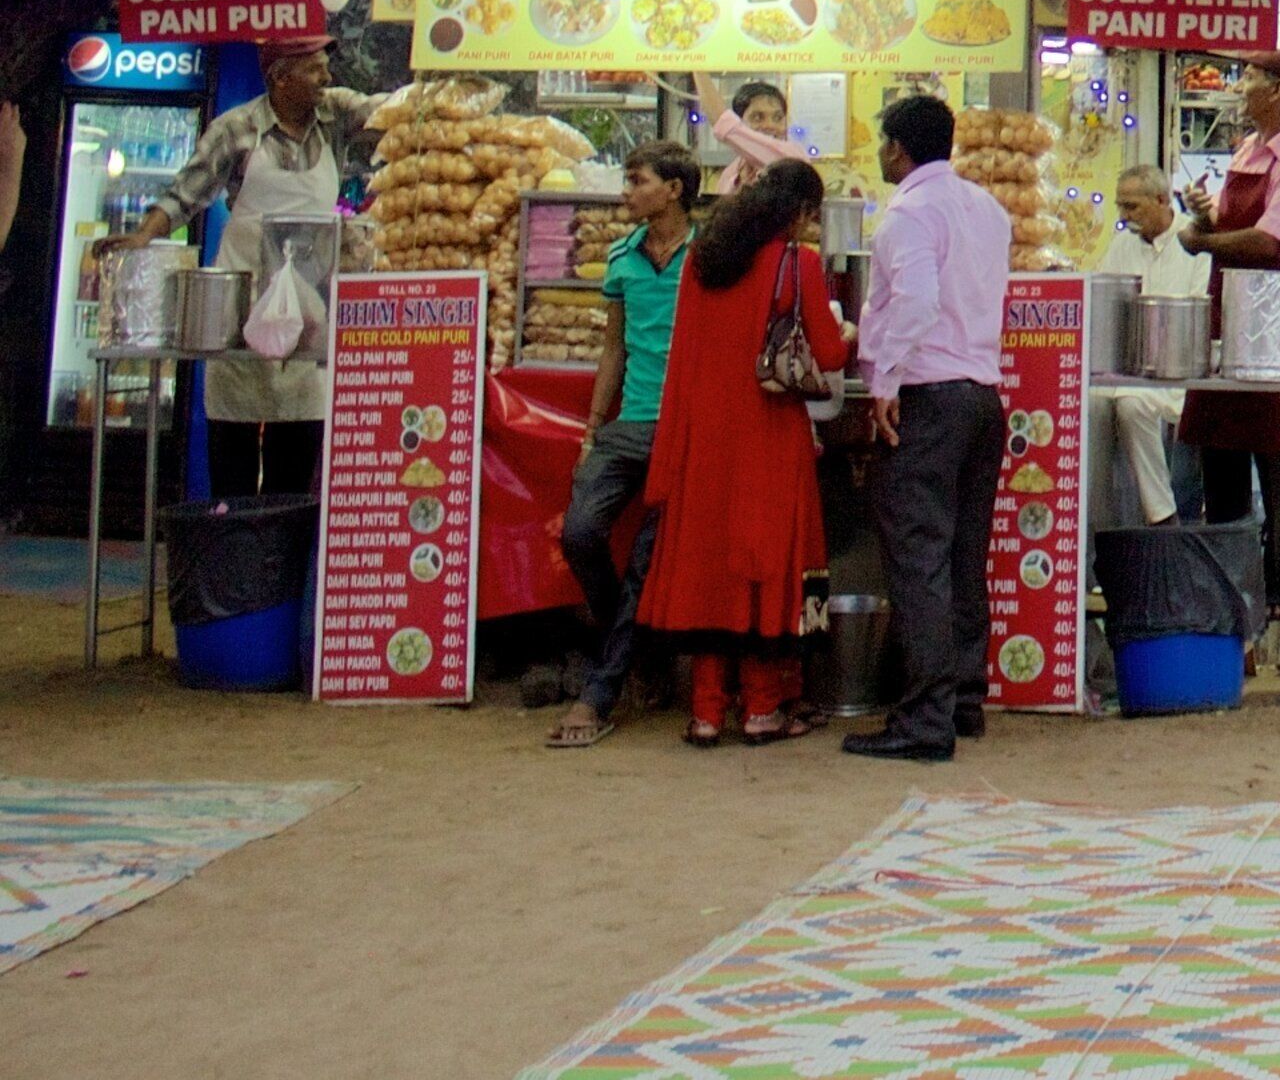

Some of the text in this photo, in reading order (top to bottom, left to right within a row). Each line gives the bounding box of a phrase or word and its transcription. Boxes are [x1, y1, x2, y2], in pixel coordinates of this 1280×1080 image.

[140, 2, 307, 36] PANI PURI
[1087, 9, 1259, 42] PANI PURI
[456, 50, 511, 61] PANI PURI
[528, 50, 554, 62] DAHI
[589, 50, 615, 62] PURI
[635, 52, 707, 62] DAHI SEV PURI
[736, 52, 814, 63] RAGDA PATTICE
[841, 52, 900, 64] SEV PURI
[934, 55, 995, 66] BHEL PURI
[114, 48, 202, 80] pepsi
[379, 284, 406, 295] STALL
[425, 284, 436, 294] 23
[338, 297, 475, 328] BHIM SINGH
[1008, 299, 1080, 329] SINGH
[342, 330, 470, 346] FILTER COLD PANI PURI
[1019, 332, 1075, 347] PANI PURI
[337, 352, 361, 366] COLD
[363, 352, 384, 365] PANI
[387, 351, 408, 364] PURI
[336, 373, 366, 386] RAGDA
[369, 372, 390, 385] PANI
[392, 371, 414, 384] PURI
[335, 393, 356, 406] JAIN
[359, 392, 379, 405] PANI
[381, 391, 403, 404] PURI
[334, 413, 358, 426] BHEL
[360, 412, 382, 426] PURI
[333, 433, 351, 446] SEV
[353, 432, 375, 446] PURI
[333, 453, 354, 467] JAIN
[355, 452, 379, 466] BHEL
[381, 452, 403, 465] PURI
[331, 473, 352, 486] JAIN
[354, 472, 372, 486] SEV
[375, 471, 396, 486] PURI
[331, 492, 383, 507] KOLHAPURI
[384, 492, 408, 506] BHEL
[329, 513, 360, 527] RAGDA
[362, 512, 400, 526] PATTICE
[329, 534, 350, 547] DAHI
[352, 533, 386, 547] BATATA
[388, 532, 411, 546] PURI
